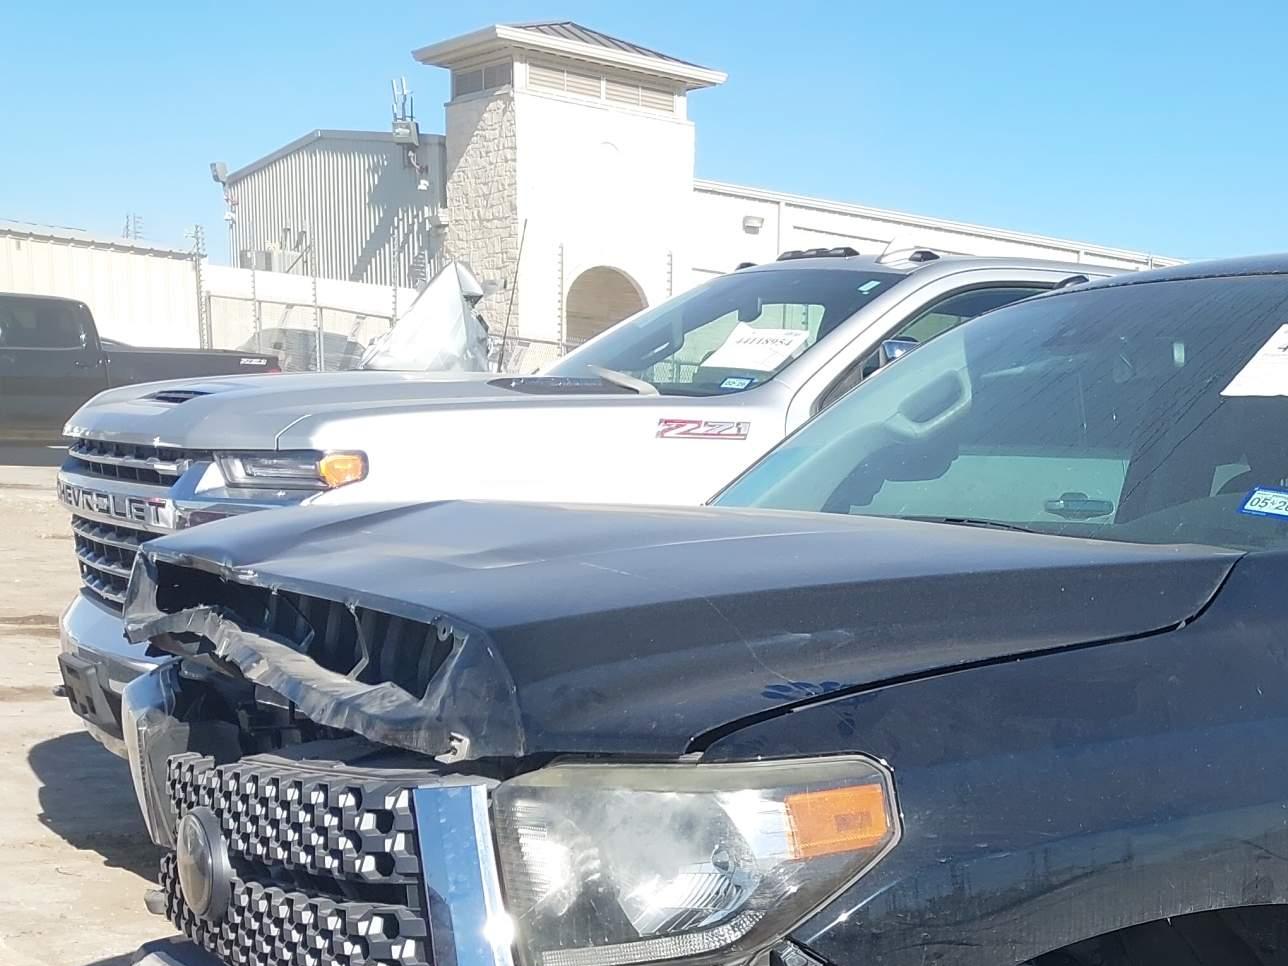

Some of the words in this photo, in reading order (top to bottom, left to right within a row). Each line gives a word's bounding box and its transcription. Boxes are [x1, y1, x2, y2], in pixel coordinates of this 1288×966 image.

[656, 418, 751, 440] Z71
[56, 480, 166, 525] CHEVROLET
[1250, 497, 1271, 508] 05
